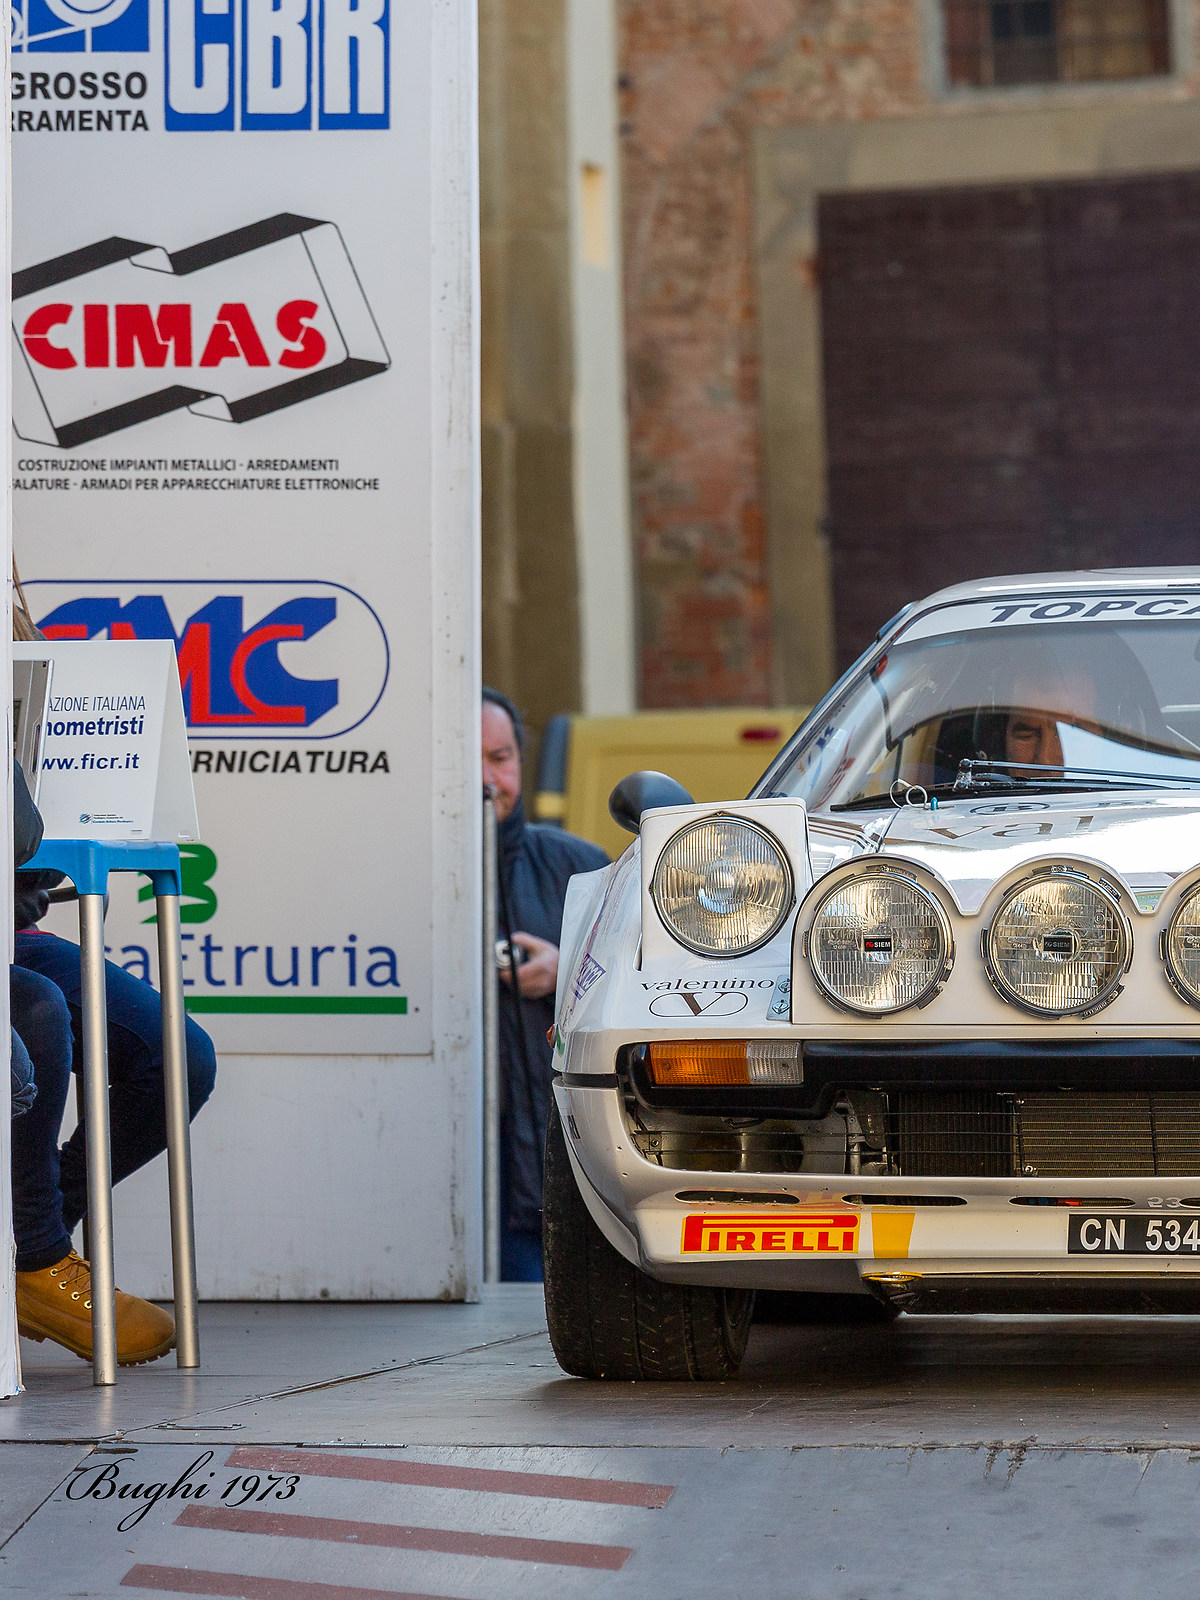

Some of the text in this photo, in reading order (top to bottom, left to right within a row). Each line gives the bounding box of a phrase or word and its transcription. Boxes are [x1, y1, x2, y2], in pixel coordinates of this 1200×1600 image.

[168, 0, 386, 115] CBR
[11, 71, 147, 100] GROSSO
[23, 299, 327, 370] CIMAS
[18, 459, 339, 471] COSTRUZIONE IMPIANTI METALLICI ARREDAMENTI
[80, 478, 132, 490] ARMADI
[135, 478, 159, 490] PER
[161, 478, 281, 490] APPARECCHIATURE
[285, 478, 380, 490] ELETTRONICHE
[92, 696, 146, 711] ITALIANA
[190, 750, 390, 774] RNICIATURA
[641, 977, 775, 991] valentino
[684, 1214, 859, 1252] PIRELLI
[1080, 1218, 1126, 1251] CN
